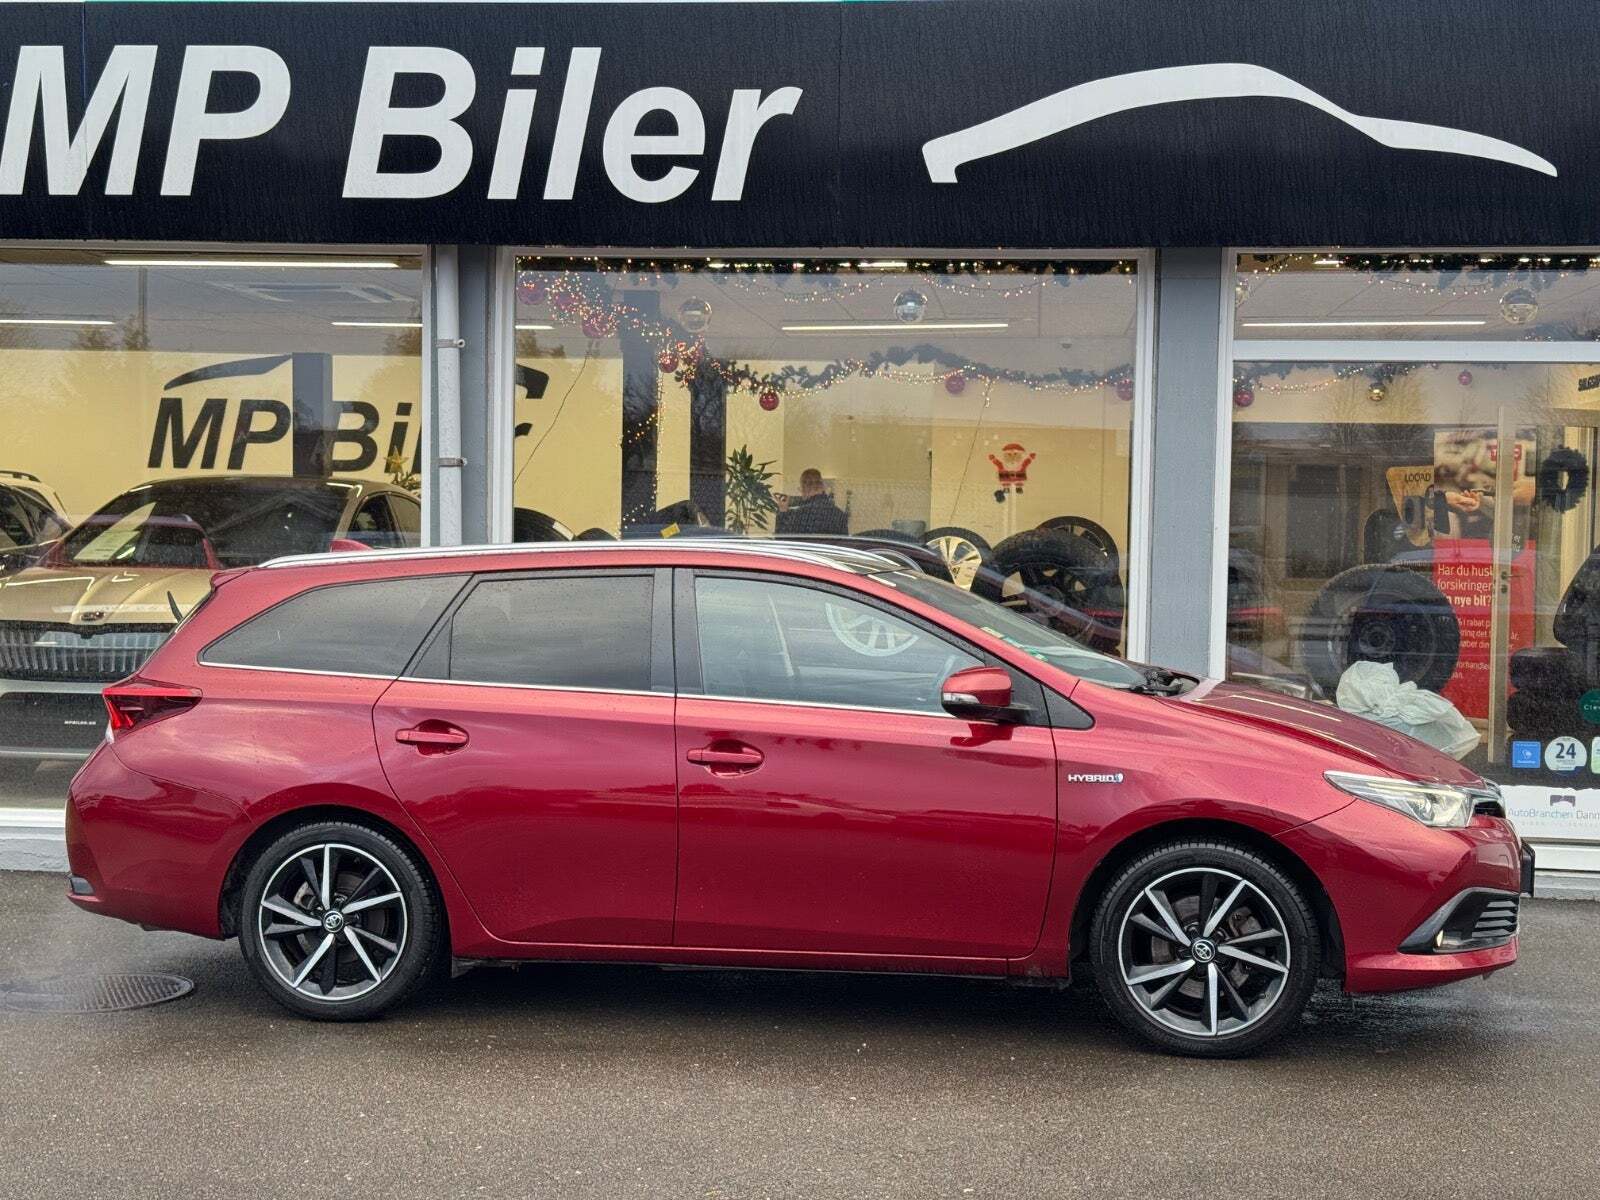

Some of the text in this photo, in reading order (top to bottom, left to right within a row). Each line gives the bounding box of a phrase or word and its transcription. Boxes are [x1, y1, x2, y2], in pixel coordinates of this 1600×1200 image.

[0, 45, 804, 204] MP Biler
[147, 397, 292, 470] MP
[1438, 564, 1453, 576] Har
[1457, 564, 1469, 576] du
[1454, 595, 1471, 607] nye
[1474, 594, 1491, 606] bil?
[1467, 618, 1485, 628] rabat
[1555, 742, 1577, 759] 24
[1067, 773, 1115, 783] HYBRID
[1508, 807, 1574, 819] AutoBranchen
